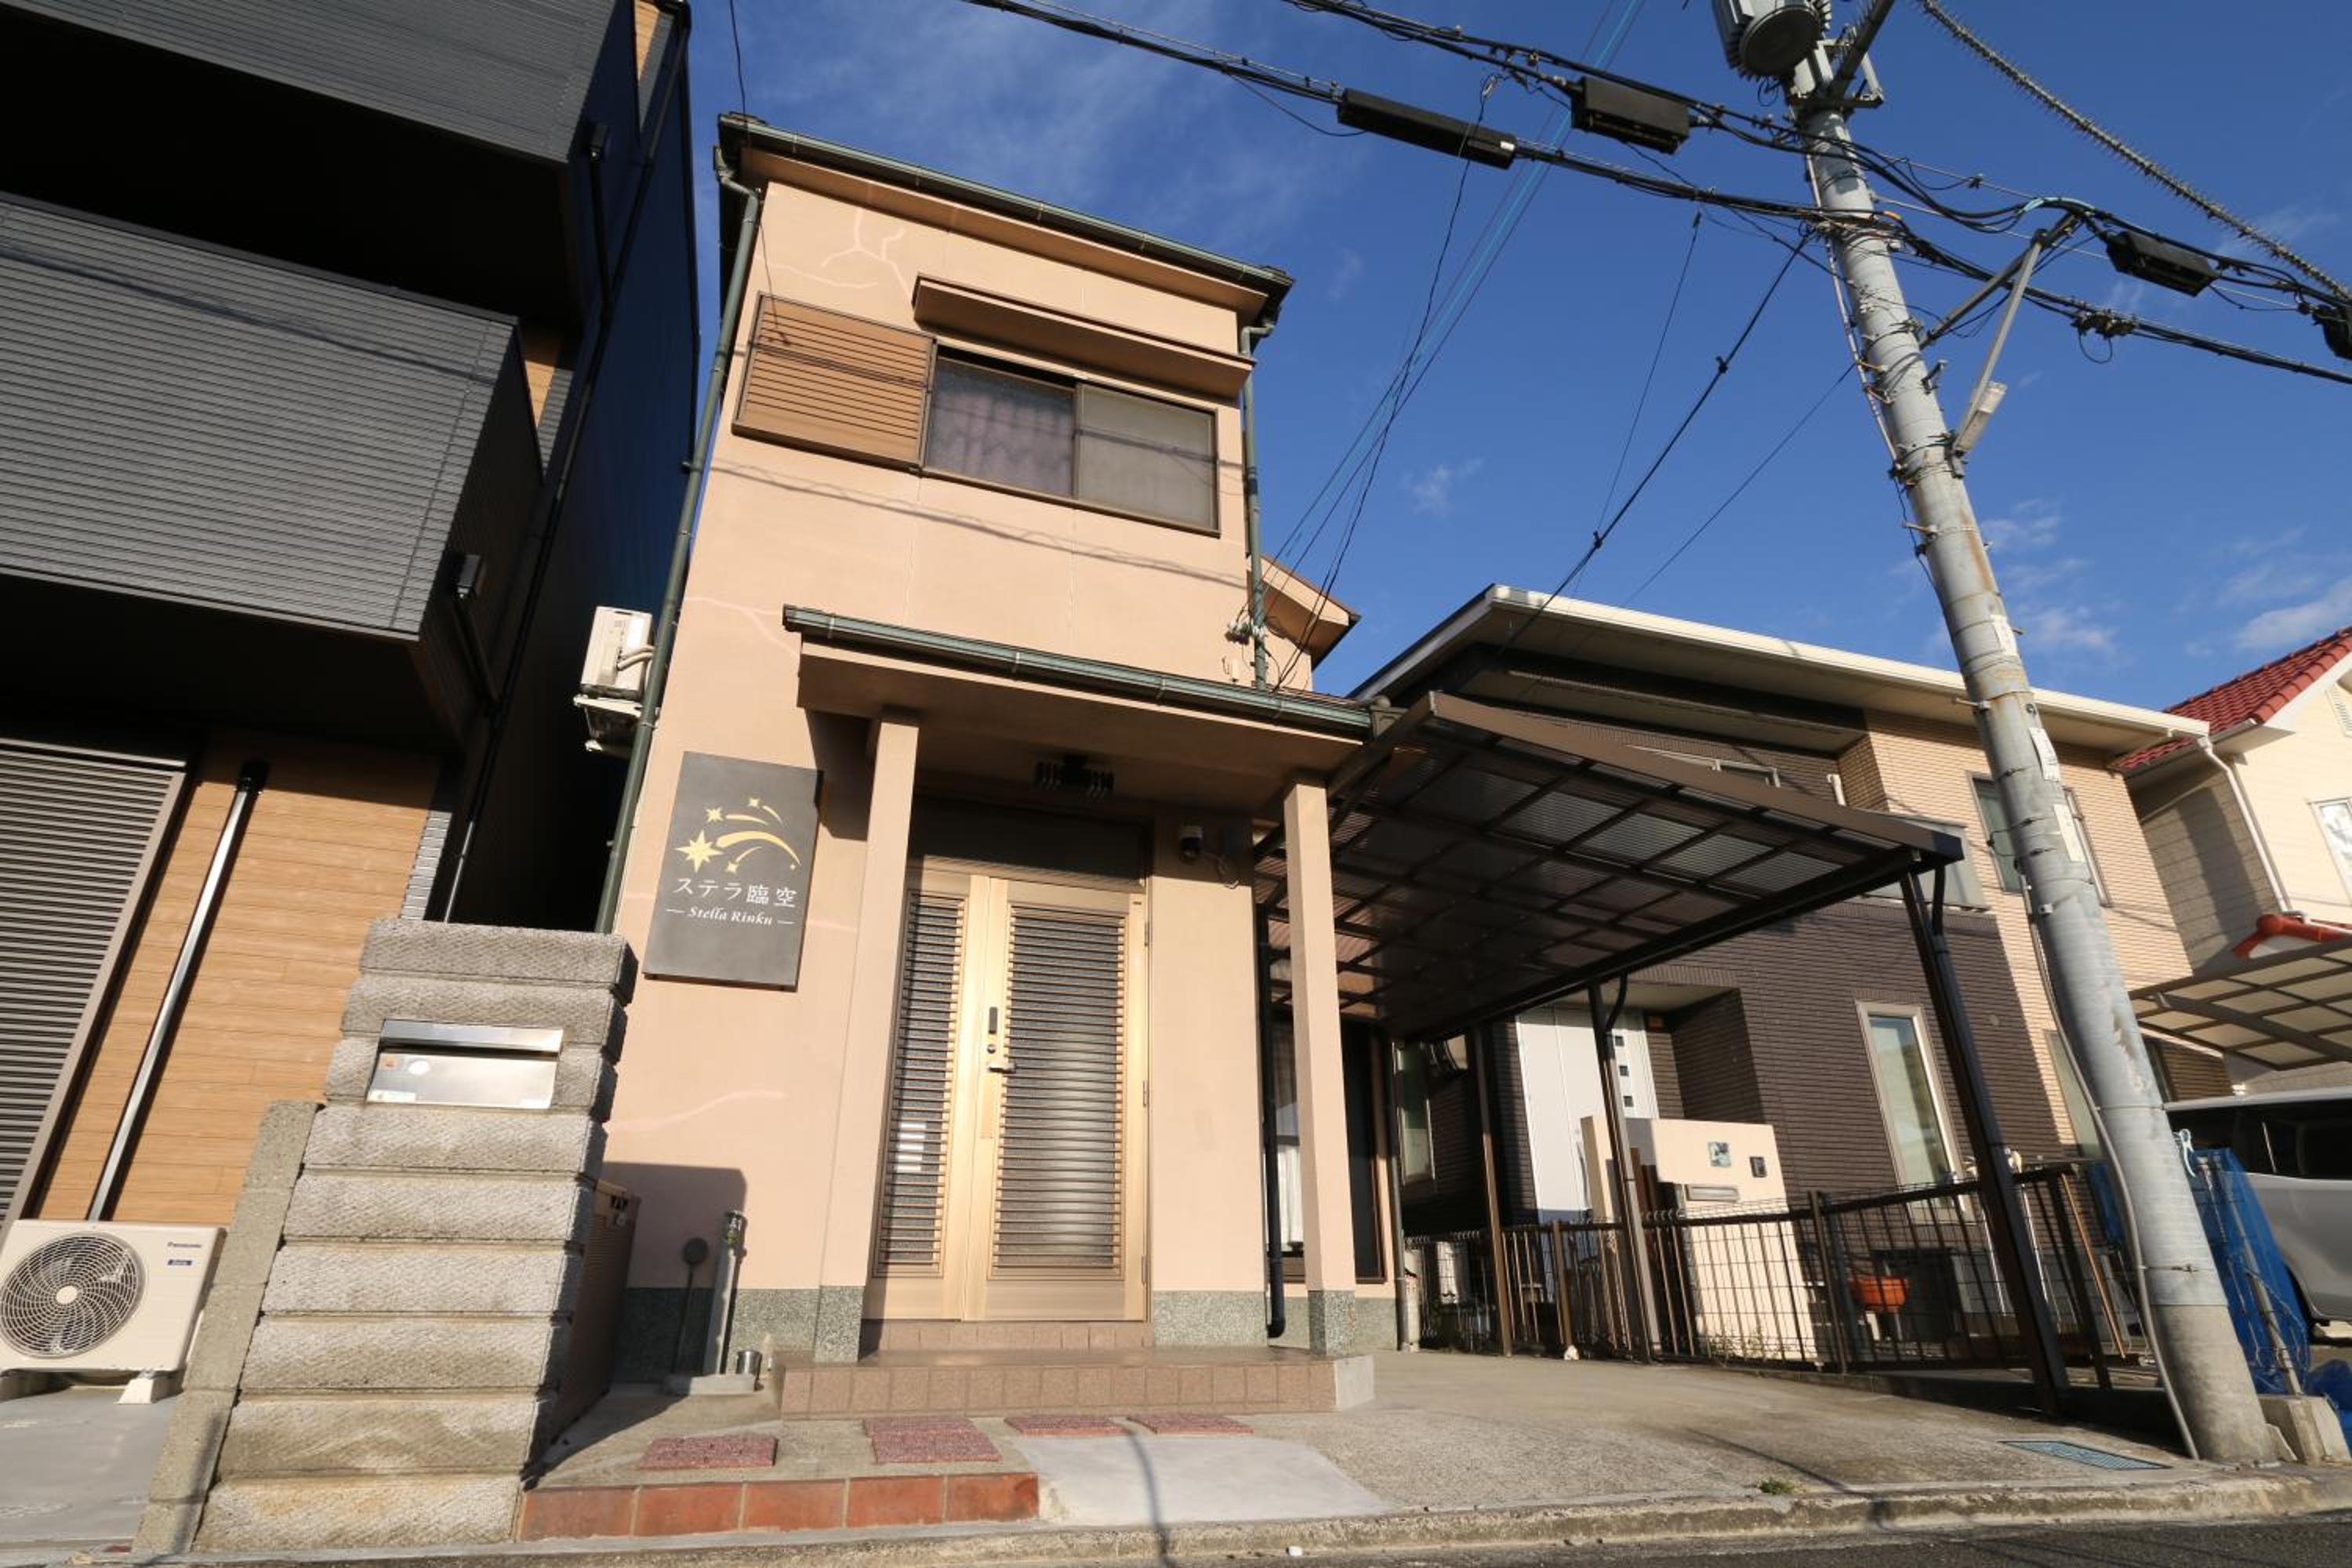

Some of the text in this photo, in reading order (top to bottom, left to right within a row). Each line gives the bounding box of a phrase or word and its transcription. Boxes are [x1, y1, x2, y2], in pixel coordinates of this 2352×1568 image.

[673, 878, 797, 908] ステラ臨空
[688, 906, 773, 925] Stella Rinku
